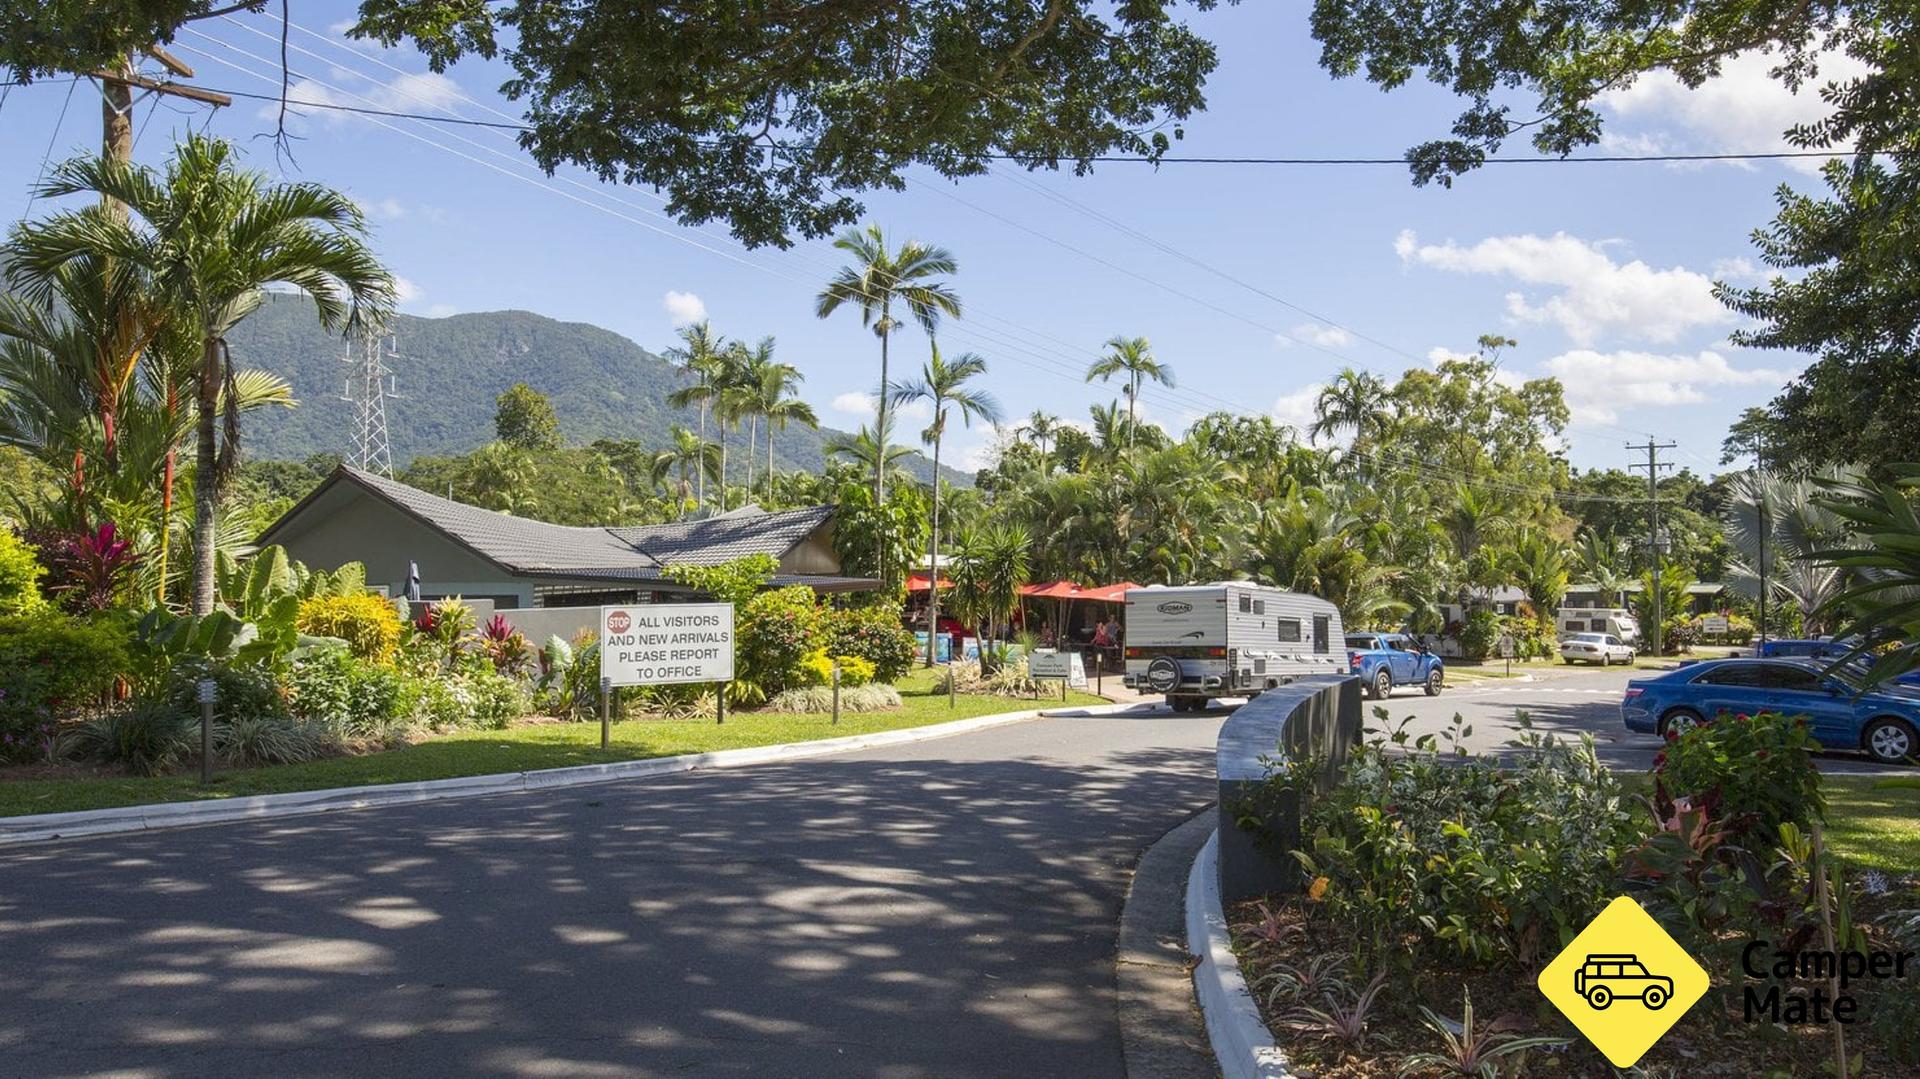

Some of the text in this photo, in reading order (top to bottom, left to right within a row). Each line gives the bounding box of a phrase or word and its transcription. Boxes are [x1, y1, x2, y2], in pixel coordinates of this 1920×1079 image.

[608, 616, 630, 628] STOP
[638, 615, 720, 628] ALL VISITORS
[607, 632, 729, 646] AND NEW ARRIVALS
[619, 648, 719, 662] PLEASE REPORT
[637, 665, 702, 679] TO OFFICE
